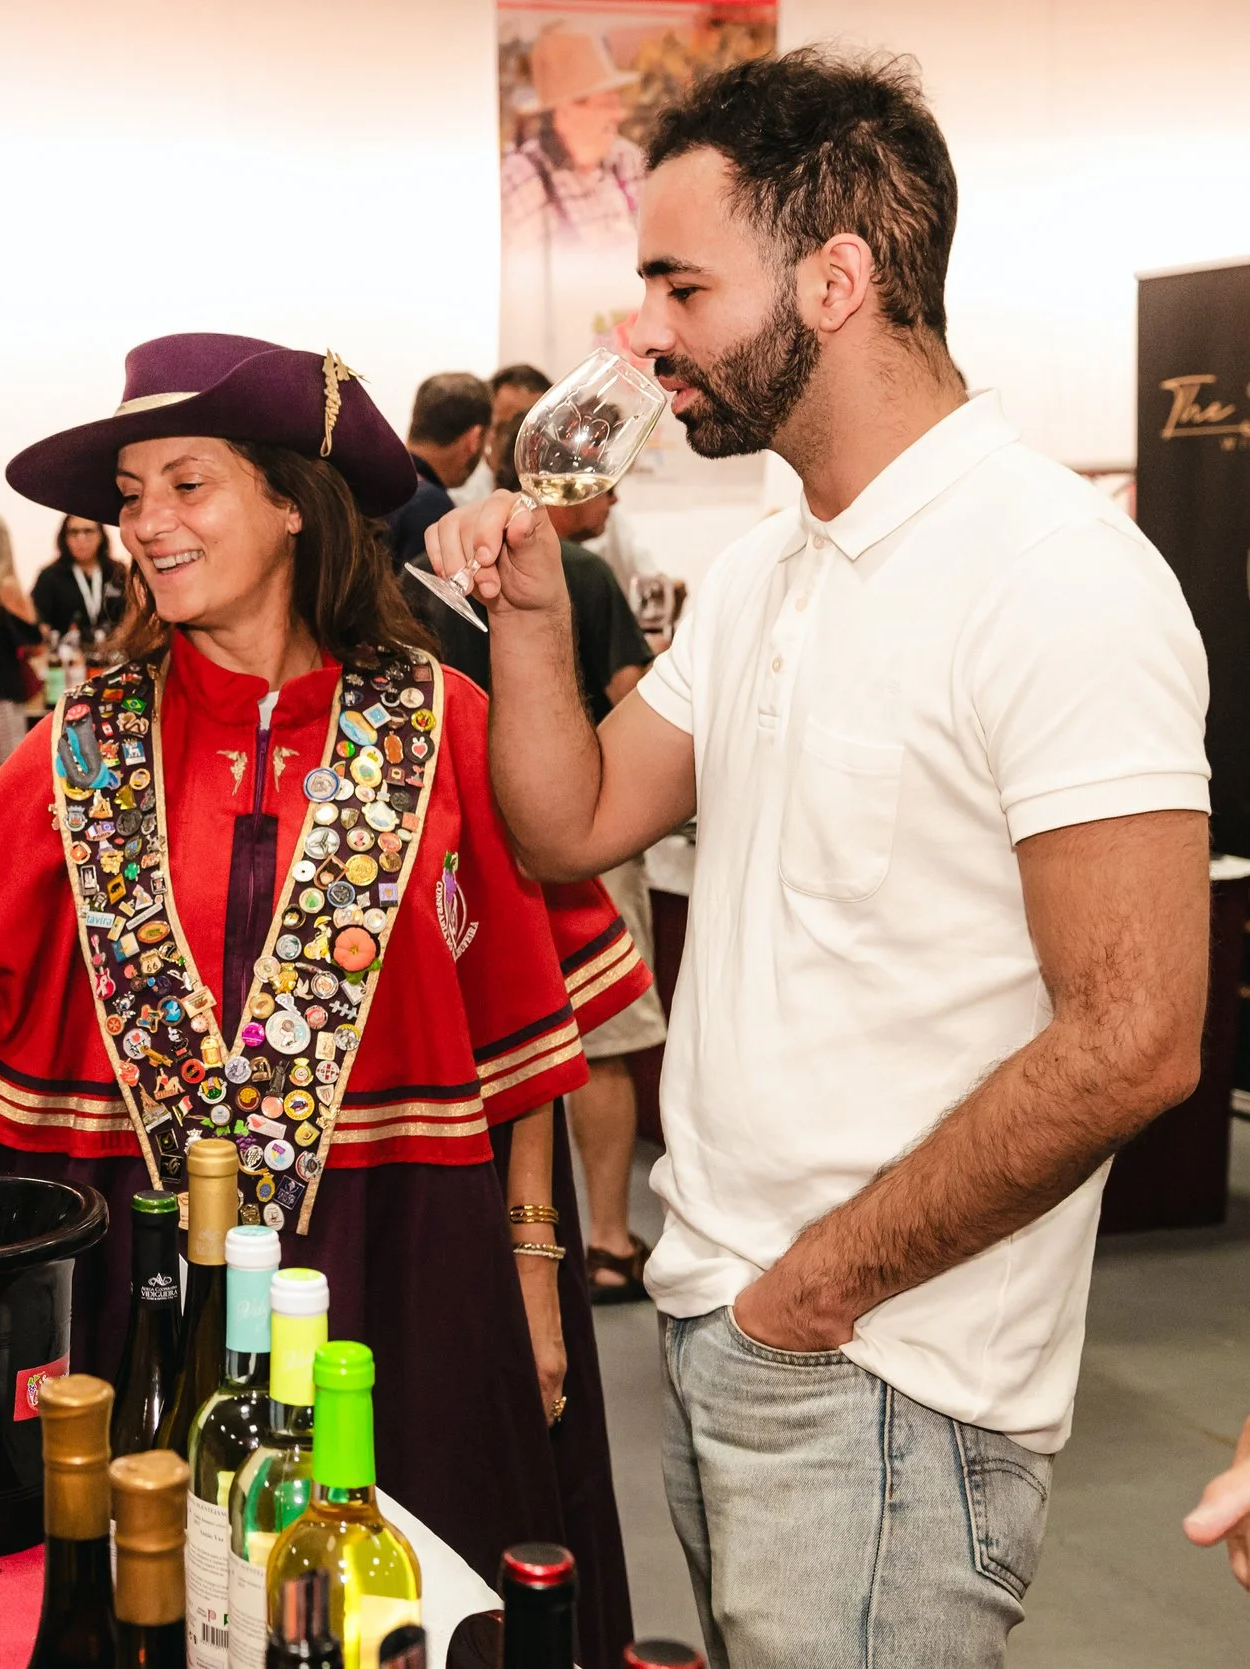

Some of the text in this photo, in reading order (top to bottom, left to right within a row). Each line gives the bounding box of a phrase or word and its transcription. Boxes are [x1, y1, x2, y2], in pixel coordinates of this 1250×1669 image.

[86, 914, 112, 926] tavira
[146, 962, 159, 972] 66
[141, 1289, 178, 1298] VIDIGUEIRA
